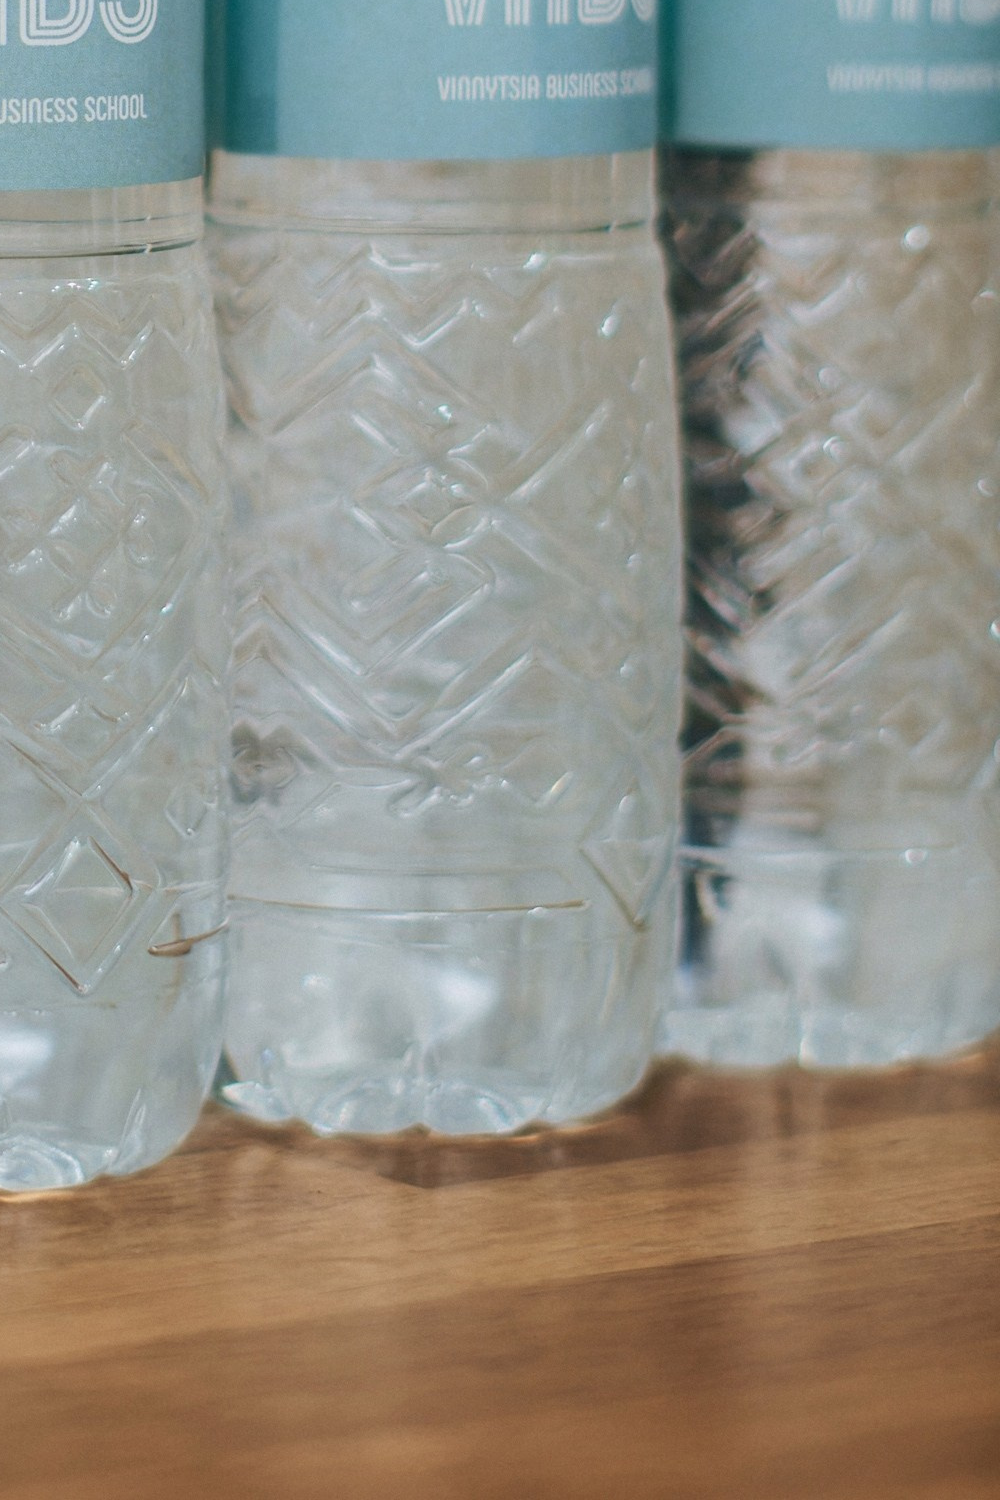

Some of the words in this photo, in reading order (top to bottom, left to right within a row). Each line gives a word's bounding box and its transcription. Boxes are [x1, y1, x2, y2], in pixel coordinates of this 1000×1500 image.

[437, 73, 540, 101] VINNYTSIA
[546, 69, 618, 99] BUSINESS
[84, 93, 148, 122] SCHOOL
